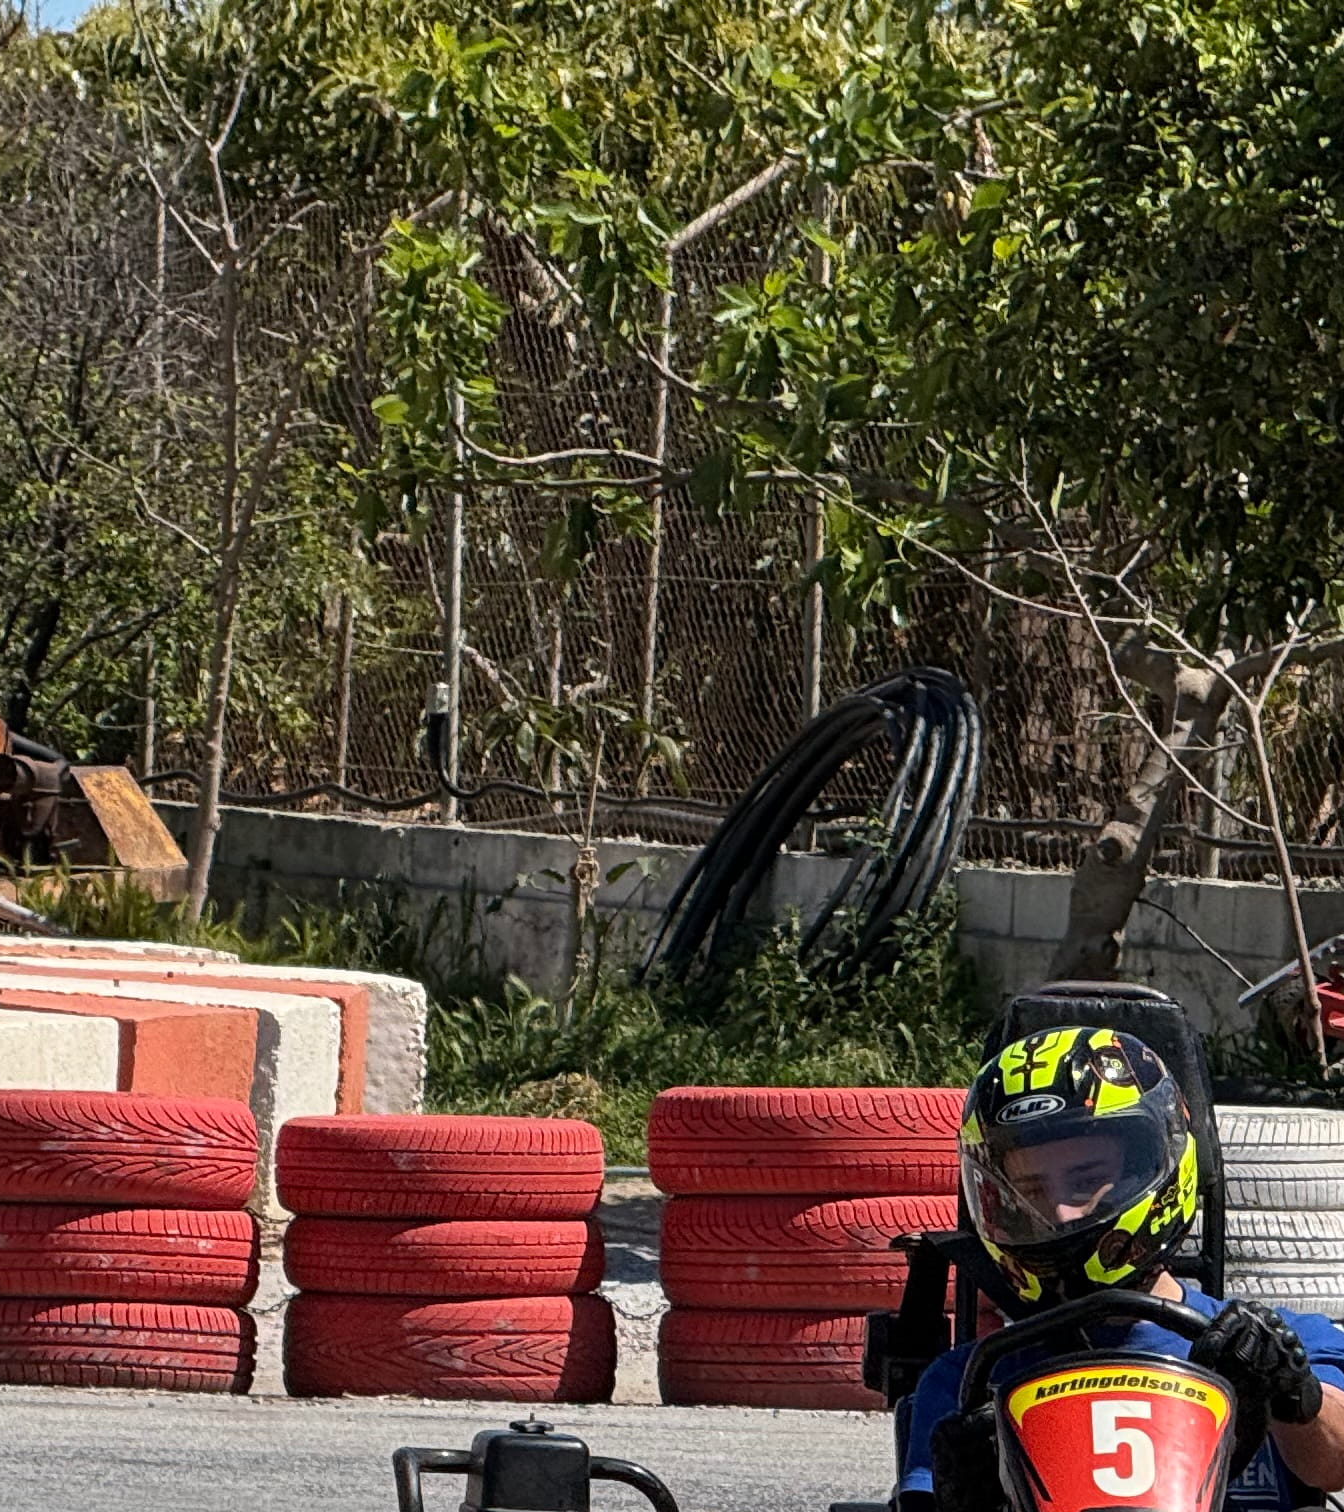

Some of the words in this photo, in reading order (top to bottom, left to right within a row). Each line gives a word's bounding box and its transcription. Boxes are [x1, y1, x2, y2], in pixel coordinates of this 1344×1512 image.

[1005, 1098, 1052, 1119] HJC
[1034, 1374, 1208, 1403] kartingdelsol.es
[1090, 1399, 1155, 1498] 5
